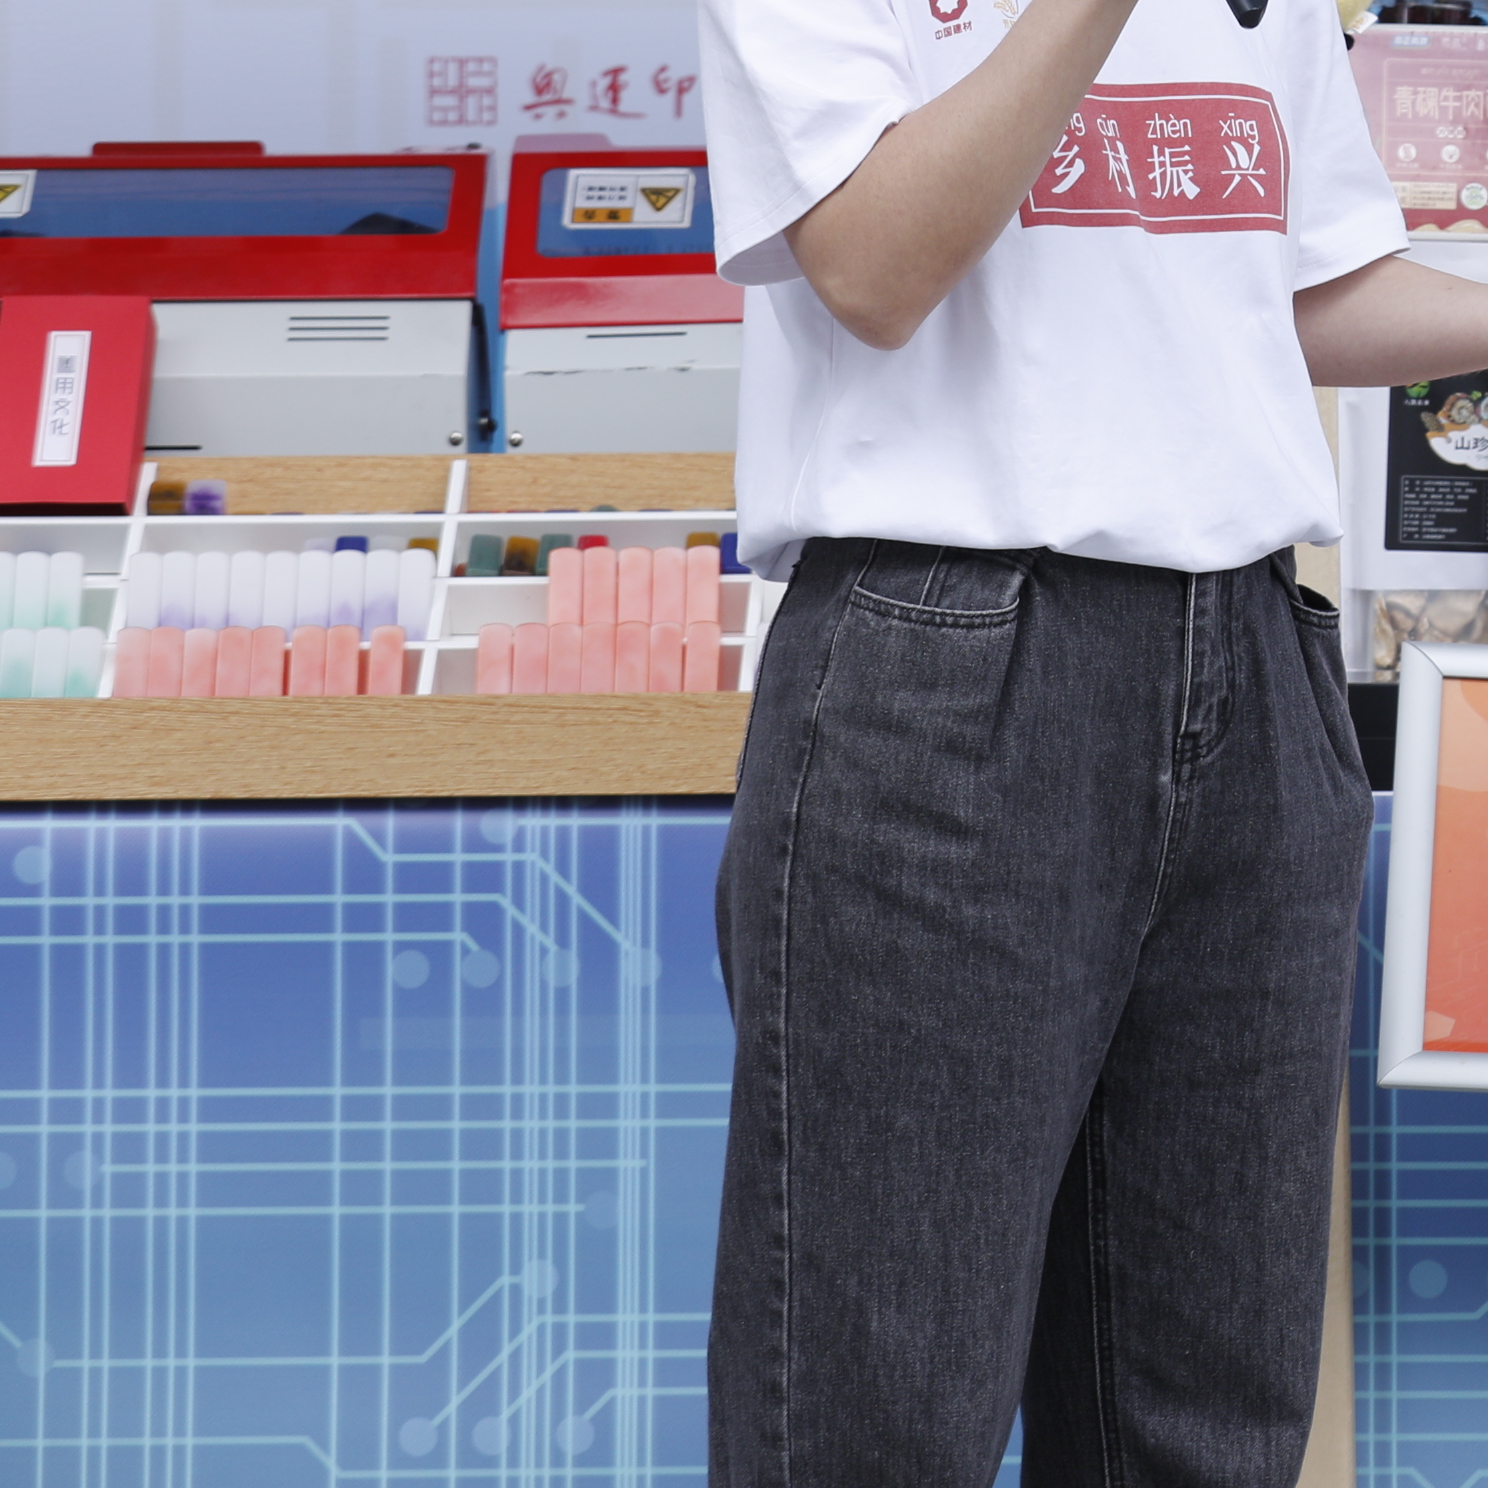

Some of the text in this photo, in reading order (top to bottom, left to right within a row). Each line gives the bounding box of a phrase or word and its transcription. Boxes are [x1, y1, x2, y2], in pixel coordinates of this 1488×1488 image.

[935, 20, 972, 40] 中国建材
[1145, 112, 1192, 139] zhèn
[1219, 112, 1259, 144] xīng
[1052, 134, 1267, 200] 乡村振兴
